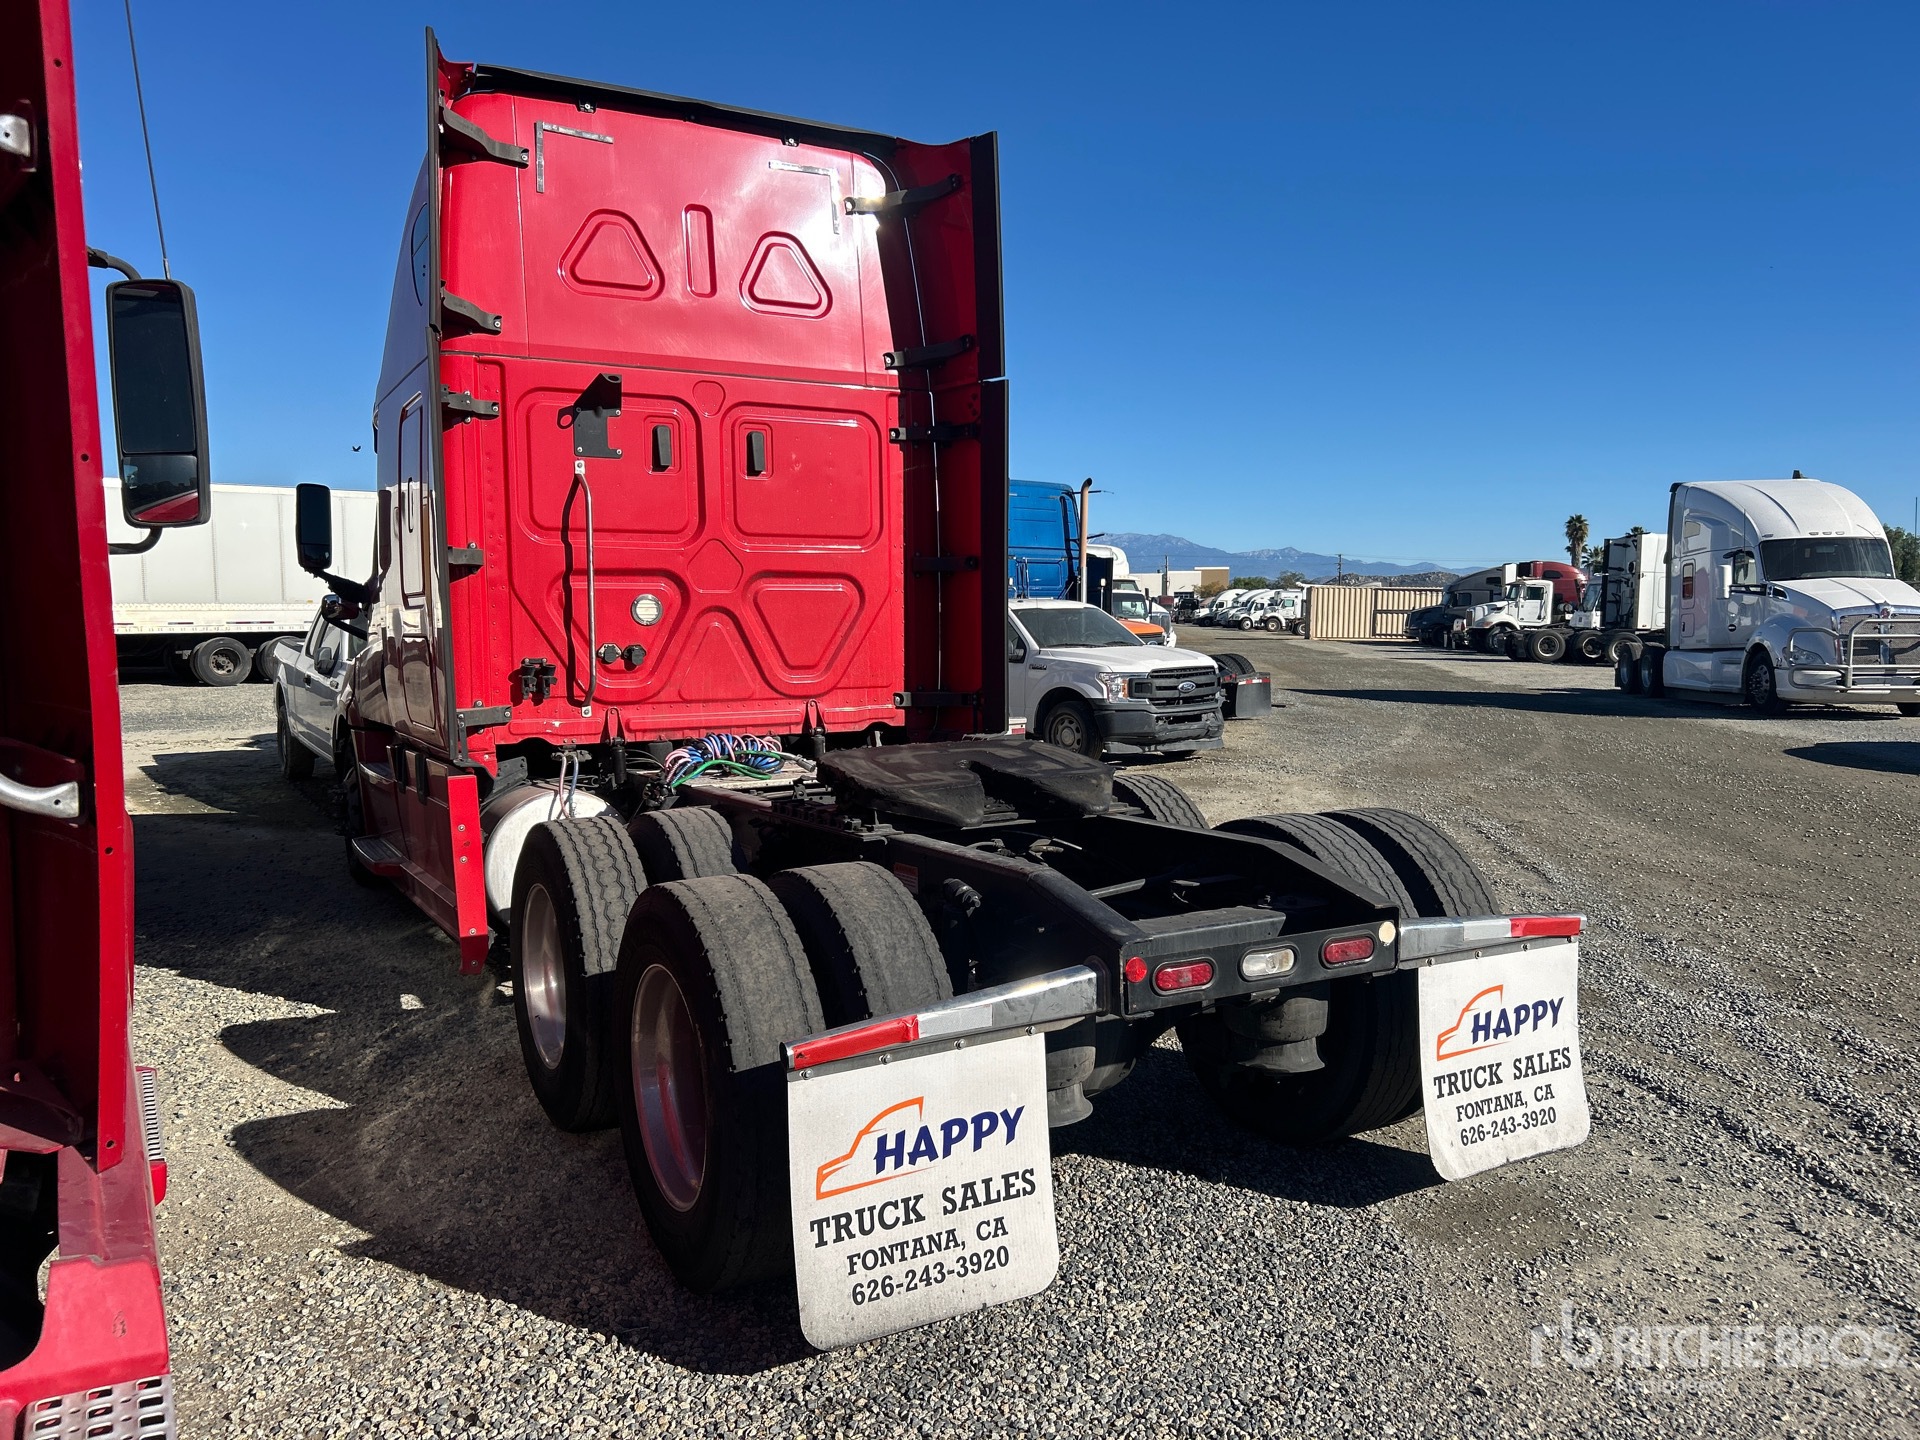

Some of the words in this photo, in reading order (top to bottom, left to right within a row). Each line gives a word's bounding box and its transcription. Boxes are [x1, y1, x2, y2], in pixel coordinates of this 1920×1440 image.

[1471, 997, 1564, 1045] HAPPY
[1433, 1062, 1503, 1099] TRUCK
[1513, 1046, 1571, 1081] SALES
[1456, 1091, 1528, 1122] FONTANA,
[1534, 1084, 1555, 1102] CA
[1460, 1106, 1557, 1146] 626-243-3920
[873, 1105, 1025, 1175] HAPPY
[809, 1193, 926, 1248] TRUCK
[941, 1168, 1036, 1216] SALES
[847, 1228, 967, 1276] FONTANA,
[976, 1216, 1009, 1241] CA
[851, 1245, 1010, 1306] 626-243-3920
